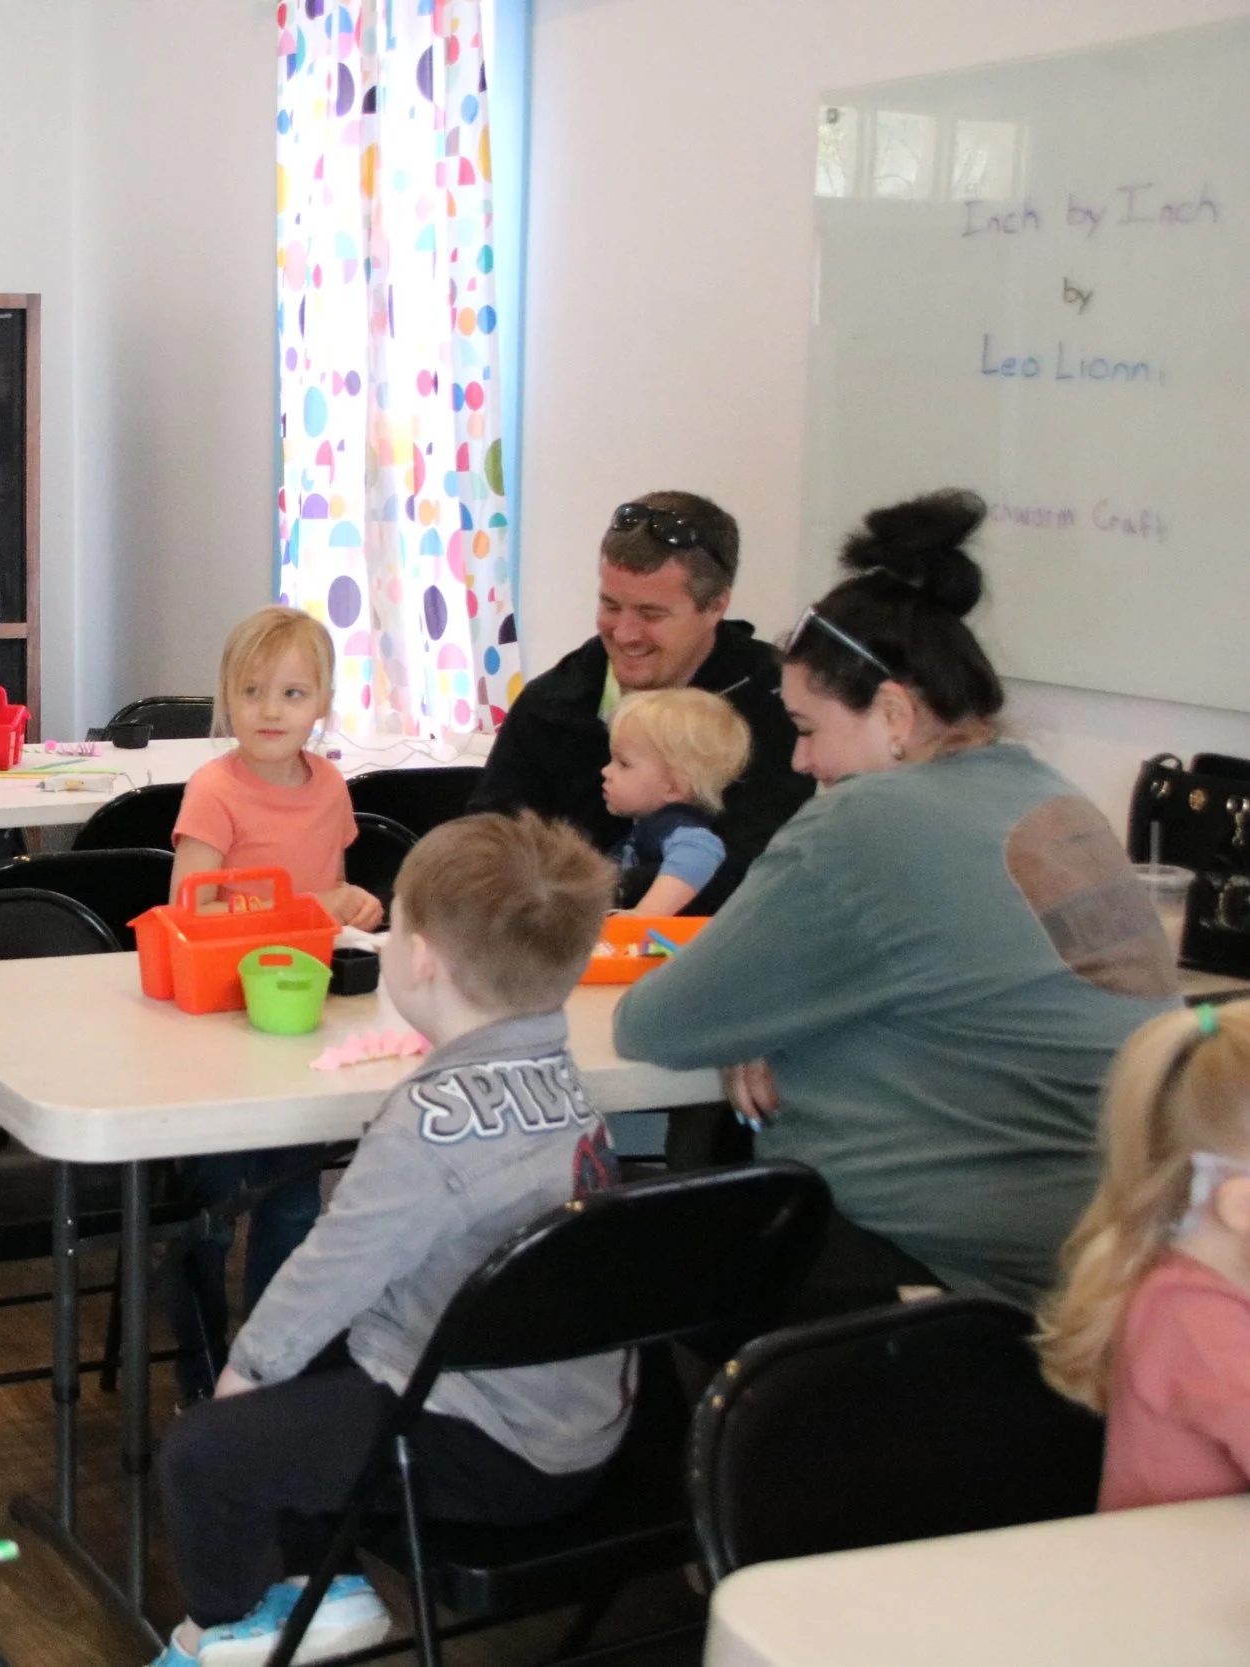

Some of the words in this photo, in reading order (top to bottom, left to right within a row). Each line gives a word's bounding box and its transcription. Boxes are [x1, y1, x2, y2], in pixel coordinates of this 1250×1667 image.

[961, 192, 1040, 238] Inch
[1065, 192, 1107, 239] by
[1115, 181, 1218, 226] Inch
[1062, 277, 1093, 315] by
[981, 333, 1041, 379] Leo
[989, 502, 1076, 528] chworm
